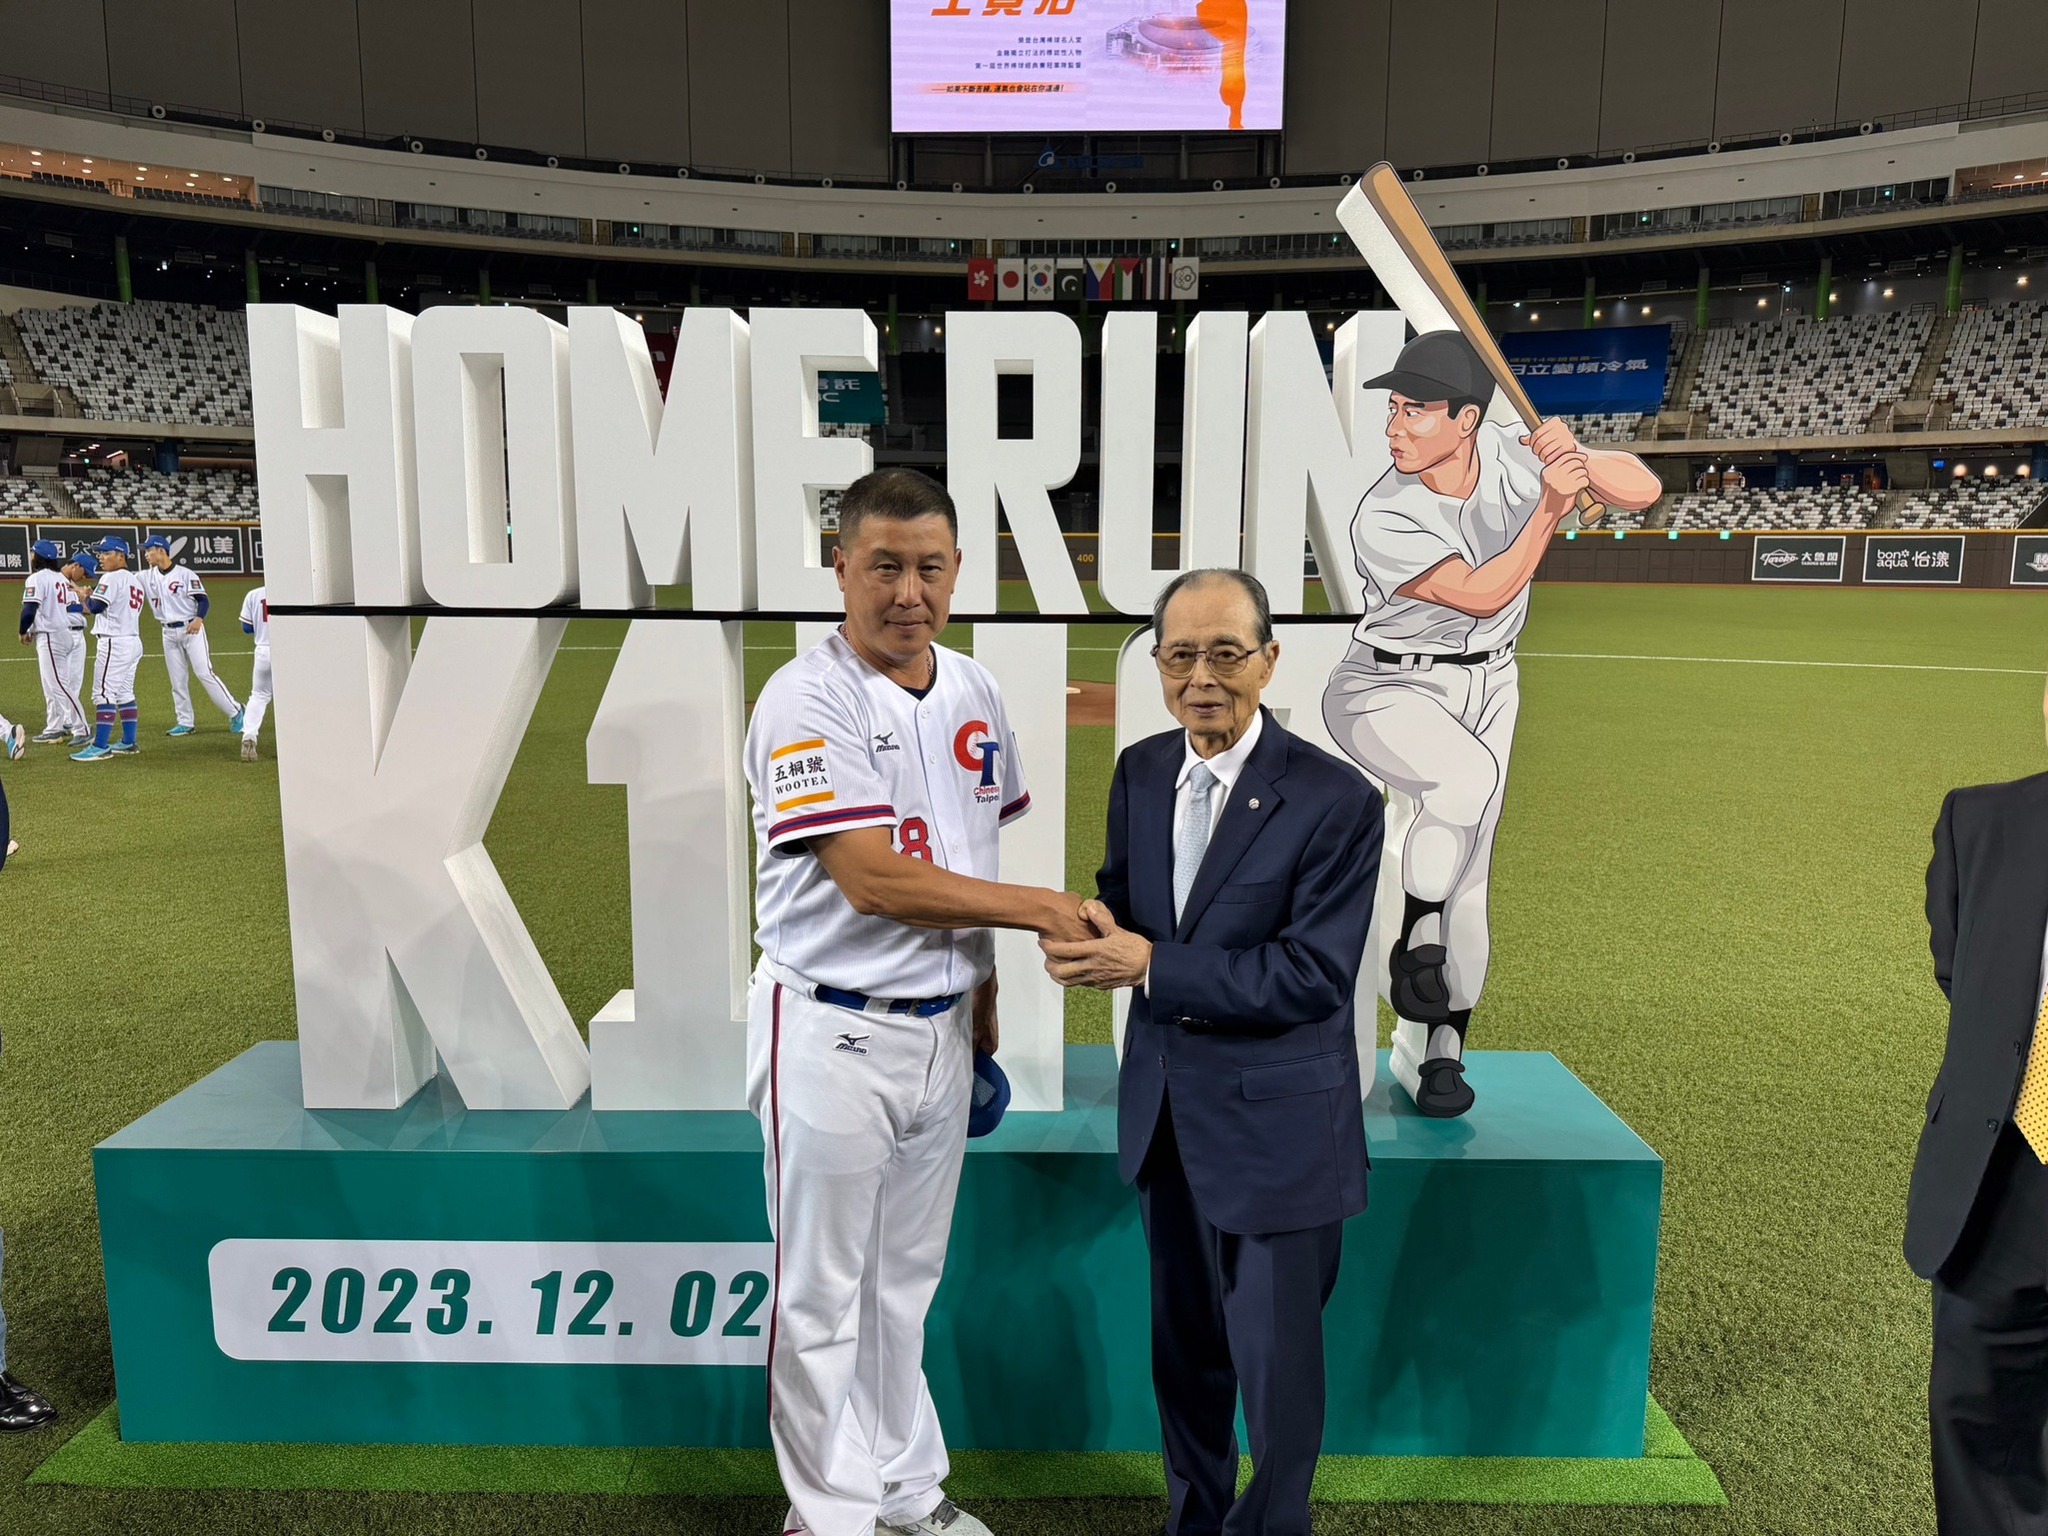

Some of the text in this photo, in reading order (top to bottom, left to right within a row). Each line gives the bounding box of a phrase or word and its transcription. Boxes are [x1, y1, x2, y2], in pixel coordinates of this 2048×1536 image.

[246, 304, 1406, 616] HOME RUN
[193, 535, 234, 555] 小美
[1877, 549, 1901, 559] bon
[193, 556, 235, 565] SHAOMEI
[1076, 553, 1095, 563] 400
[1760, 552, 1799, 567] Taroko
[1801, 551, 1839, 562] 大魯閣
[1876, 559, 1909, 570] aqua
[1911, 550, 1950, 568] 怡漾
[55, 582, 67, 605] 21
[129, 585, 144, 612] 55
[774, 756, 826, 783] 五桐號
[775, 775, 828, 795] WOOTEA
[267, 1266, 770, 1338] 2023. 12. 02
